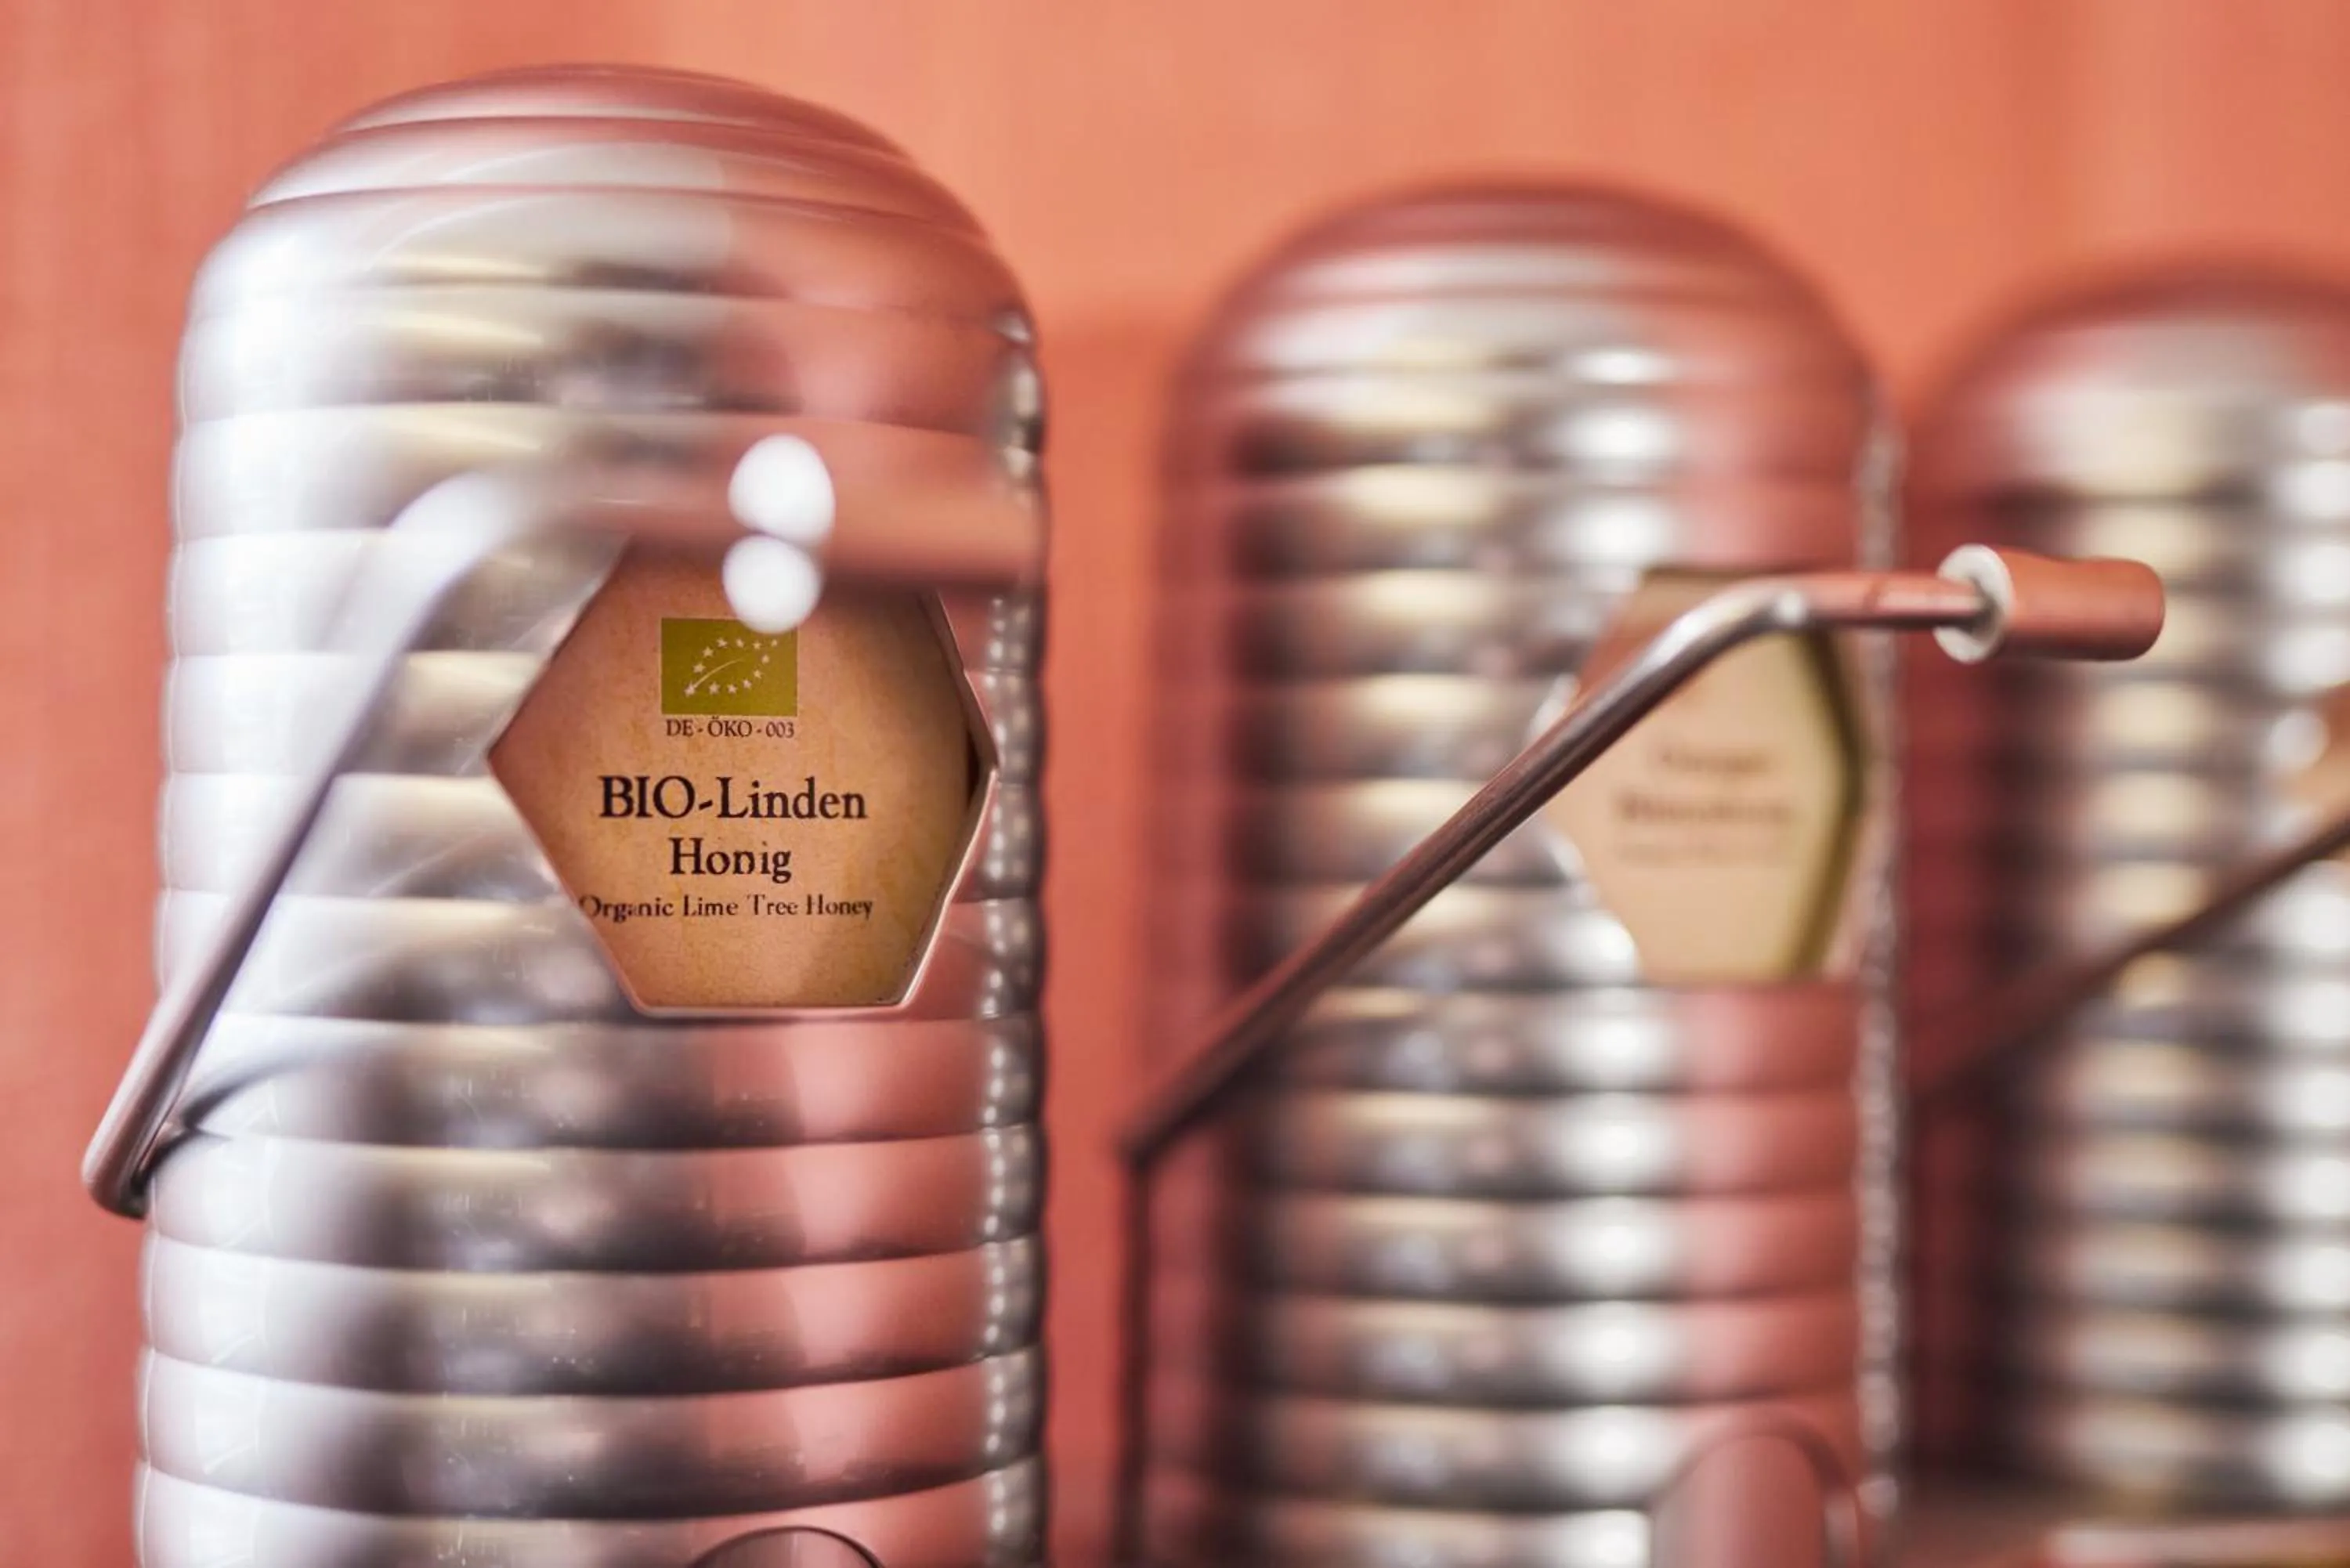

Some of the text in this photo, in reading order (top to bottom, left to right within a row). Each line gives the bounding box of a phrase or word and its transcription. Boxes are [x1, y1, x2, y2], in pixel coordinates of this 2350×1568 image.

[598, 775, 868, 820] BIO-Linden
[668, 836, 793, 884] Honig
[579, 894, 874, 923] Organic Lime Tree Honey
